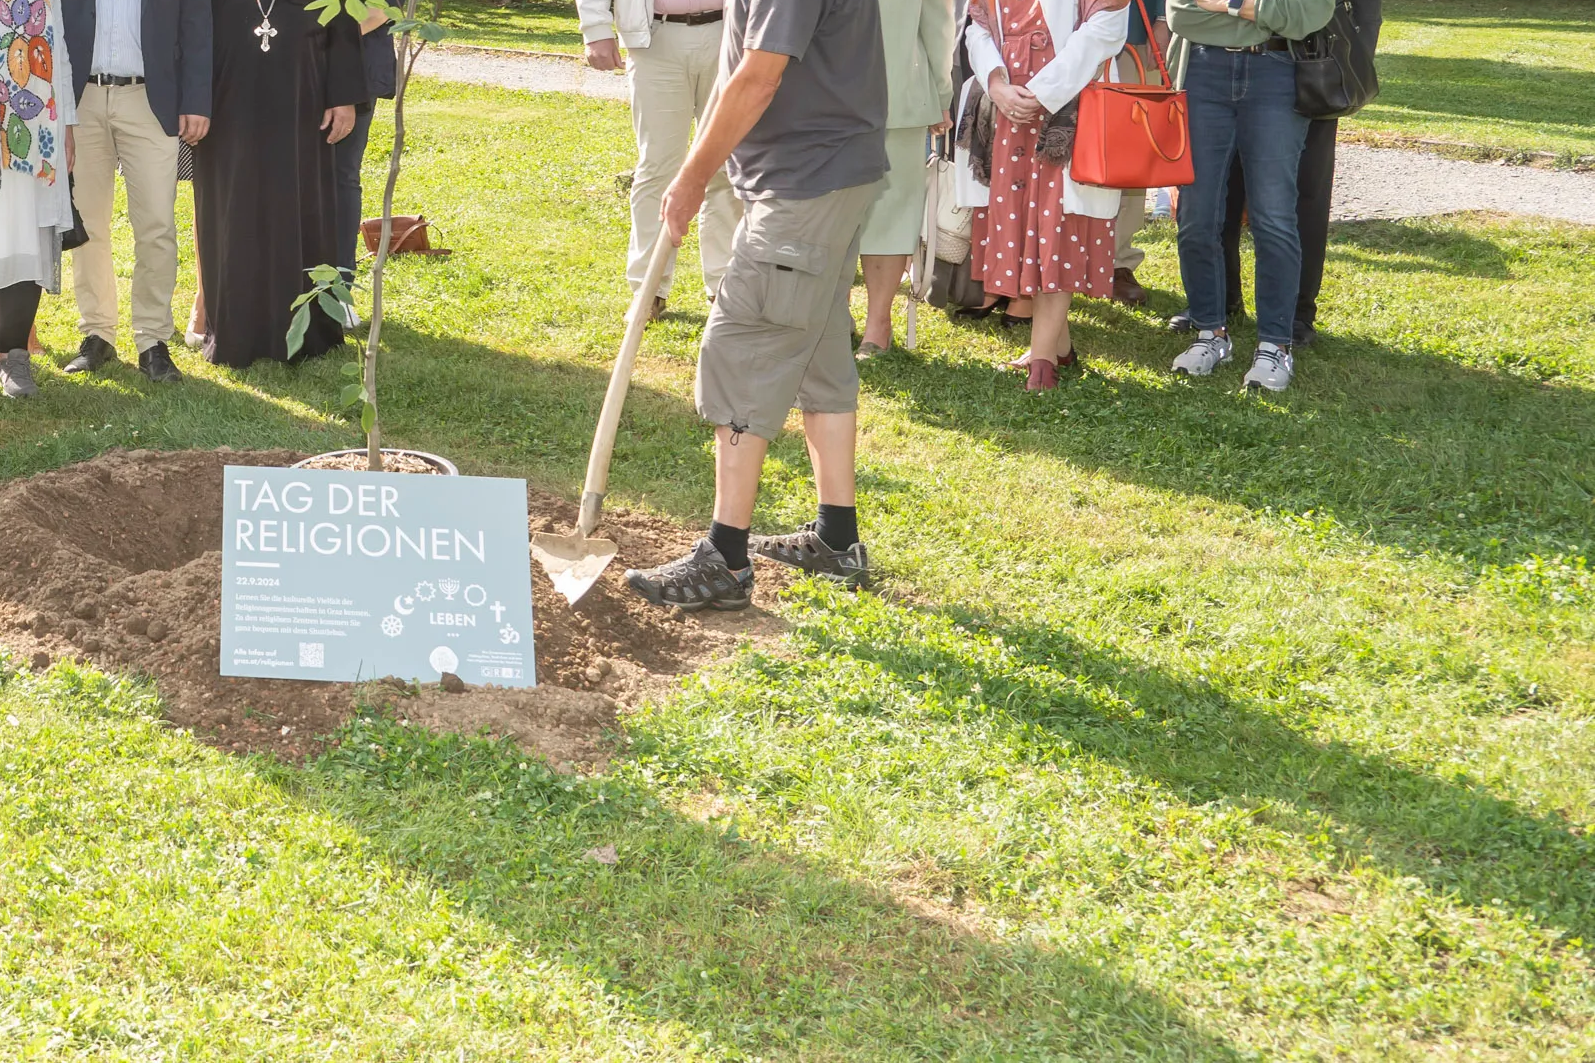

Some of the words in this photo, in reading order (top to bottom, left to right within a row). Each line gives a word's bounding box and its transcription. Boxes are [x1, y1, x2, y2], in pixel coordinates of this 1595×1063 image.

[234, 480, 313, 514] TAG
[328, 483, 400, 518] DER
[235, 518, 485, 563] RELIGIONEN
[236, 577, 280, 587] 22.9.2024
[235, 593, 259, 601] Lernen
[271, 594, 282, 602] die
[341, 598, 353, 606] der
[245, 614, 258, 622] den
[429, 612, 476, 627] LEBEN
[265, 649, 277, 657] auf
